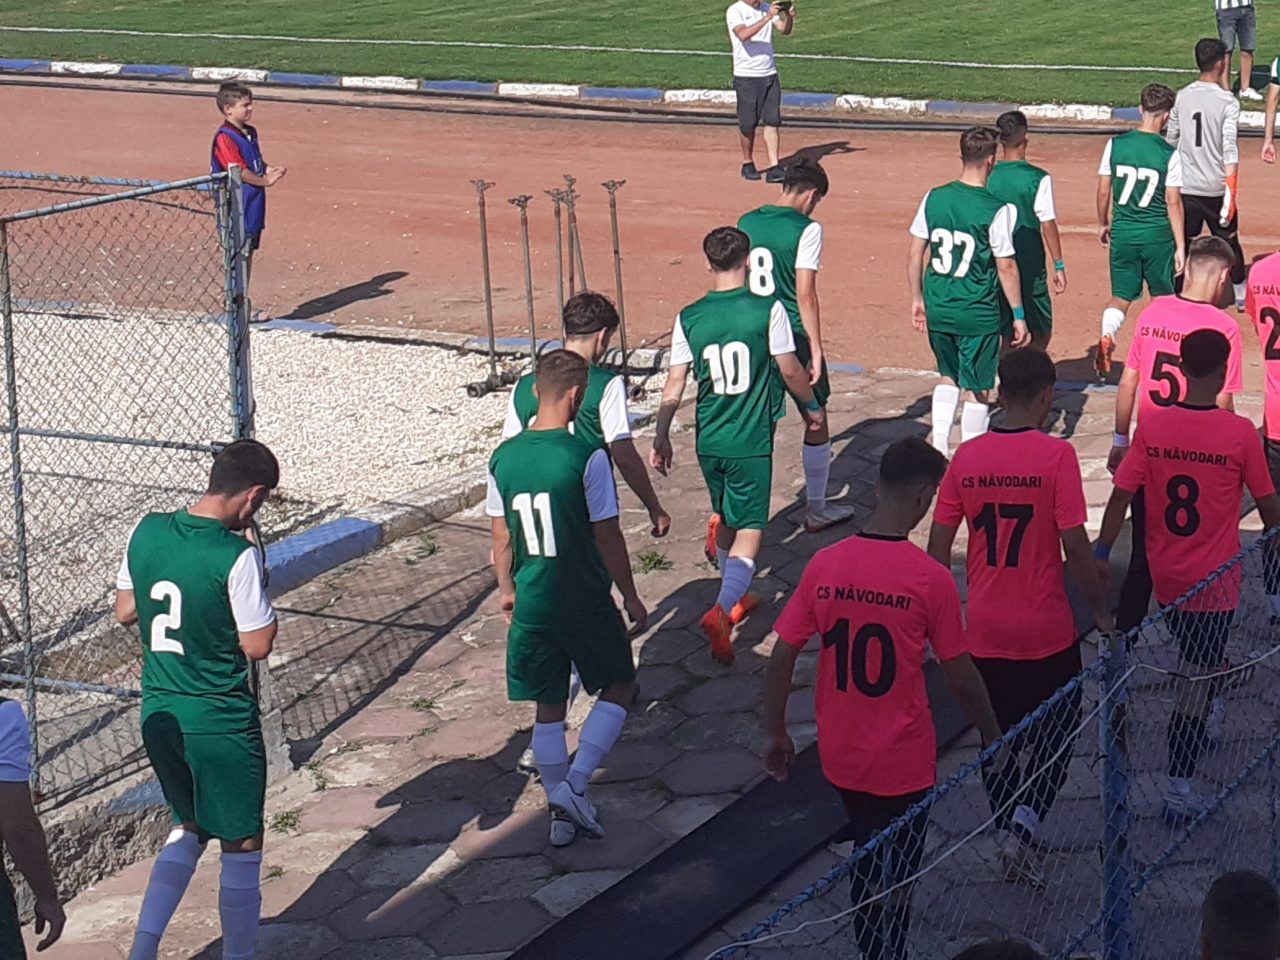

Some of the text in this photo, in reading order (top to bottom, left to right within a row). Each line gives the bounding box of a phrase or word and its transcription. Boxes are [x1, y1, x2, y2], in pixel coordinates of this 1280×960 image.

[1192, 112, 1202, 147] 1
[1116, 165, 1160, 208] 77
[750, 247, 775, 296] 8
[931, 228, 975, 277] 37
[1141, 326, 1150, 337] CS
[703, 341, 750, 395] 10
[1149, 350, 1182, 407] 5
[1146, 446, 1160, 458] CS
[961, 476, 975, 488] CS
[1165, 473, 1200, 536] 8
[512, 492, 557, 557] 11
[972, 502, 1034, 567] 17
[817, 586, 831, 600] CS
[150, 580, 185, 656] 2
[822, 617, 897, 697] 10
